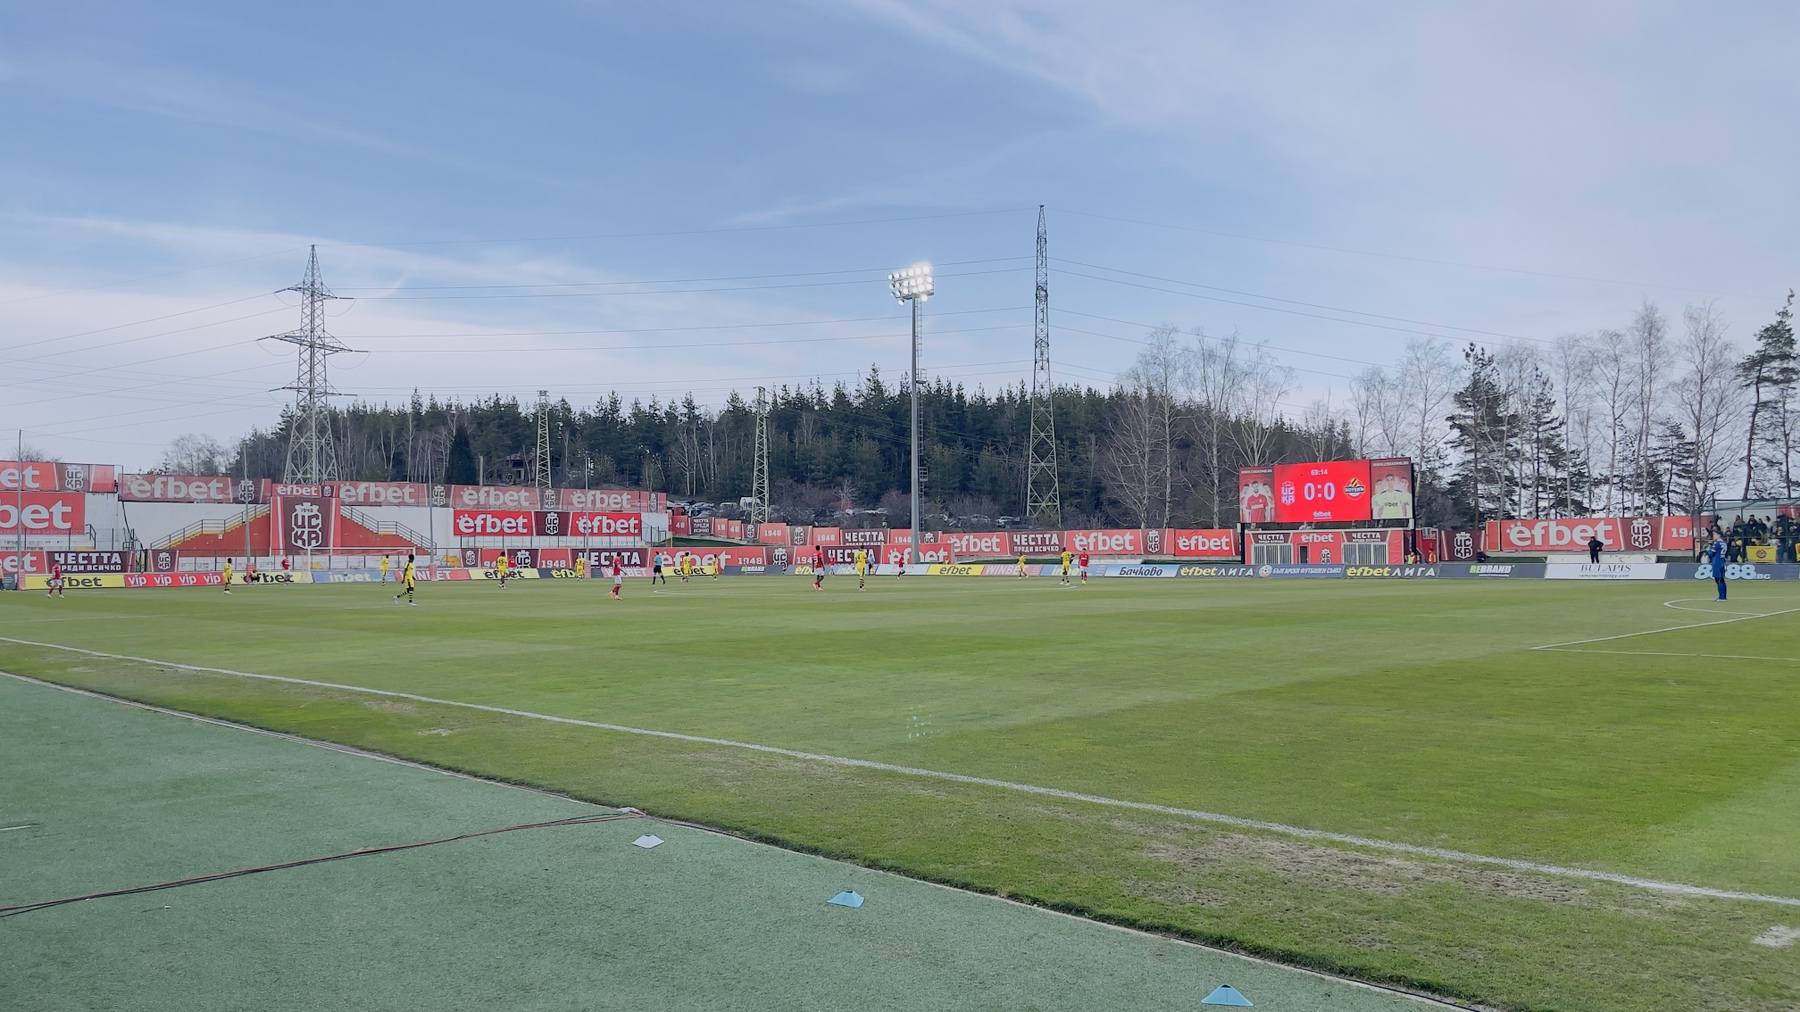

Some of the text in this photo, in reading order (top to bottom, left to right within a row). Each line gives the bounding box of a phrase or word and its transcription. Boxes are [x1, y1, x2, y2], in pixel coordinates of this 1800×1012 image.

[130, 476, 223, 499] efbet
[277, 485, 318, 496] efbet
[340, 484, 415, 503] efbet
[1304, 482, 1335, 501] 0:0
[461, 487, 530, 506] efbet
[571, 490, 631, 508] efbet
[456, 514, 528, 533] efbet
[576, 515, 639, 534] efbet
[845, 532, 884, 542] ЧЕСТТА
[1013, 534, 1059, 546] ЧЕСТТА
[1301, 534, 1334, 542] efbet
[1507, 520, 1613, 546] efbet
[947, 535, 1001, 552] efbet
[1073, 532, 1134, 551] efbet
[1177, 536, 1230, 550] efbet
[54, 553, 122, 564] ЧЕСТТА
[541, 560, 566, 568] 1948
[939, 566, 972, 575] efbet
[1119, 566, 1163, 576] Бачково
[1180, 566, 1254, 577] efbet ЛИГА
[1346, 566, 1436, 577] efbet ЛИГА
